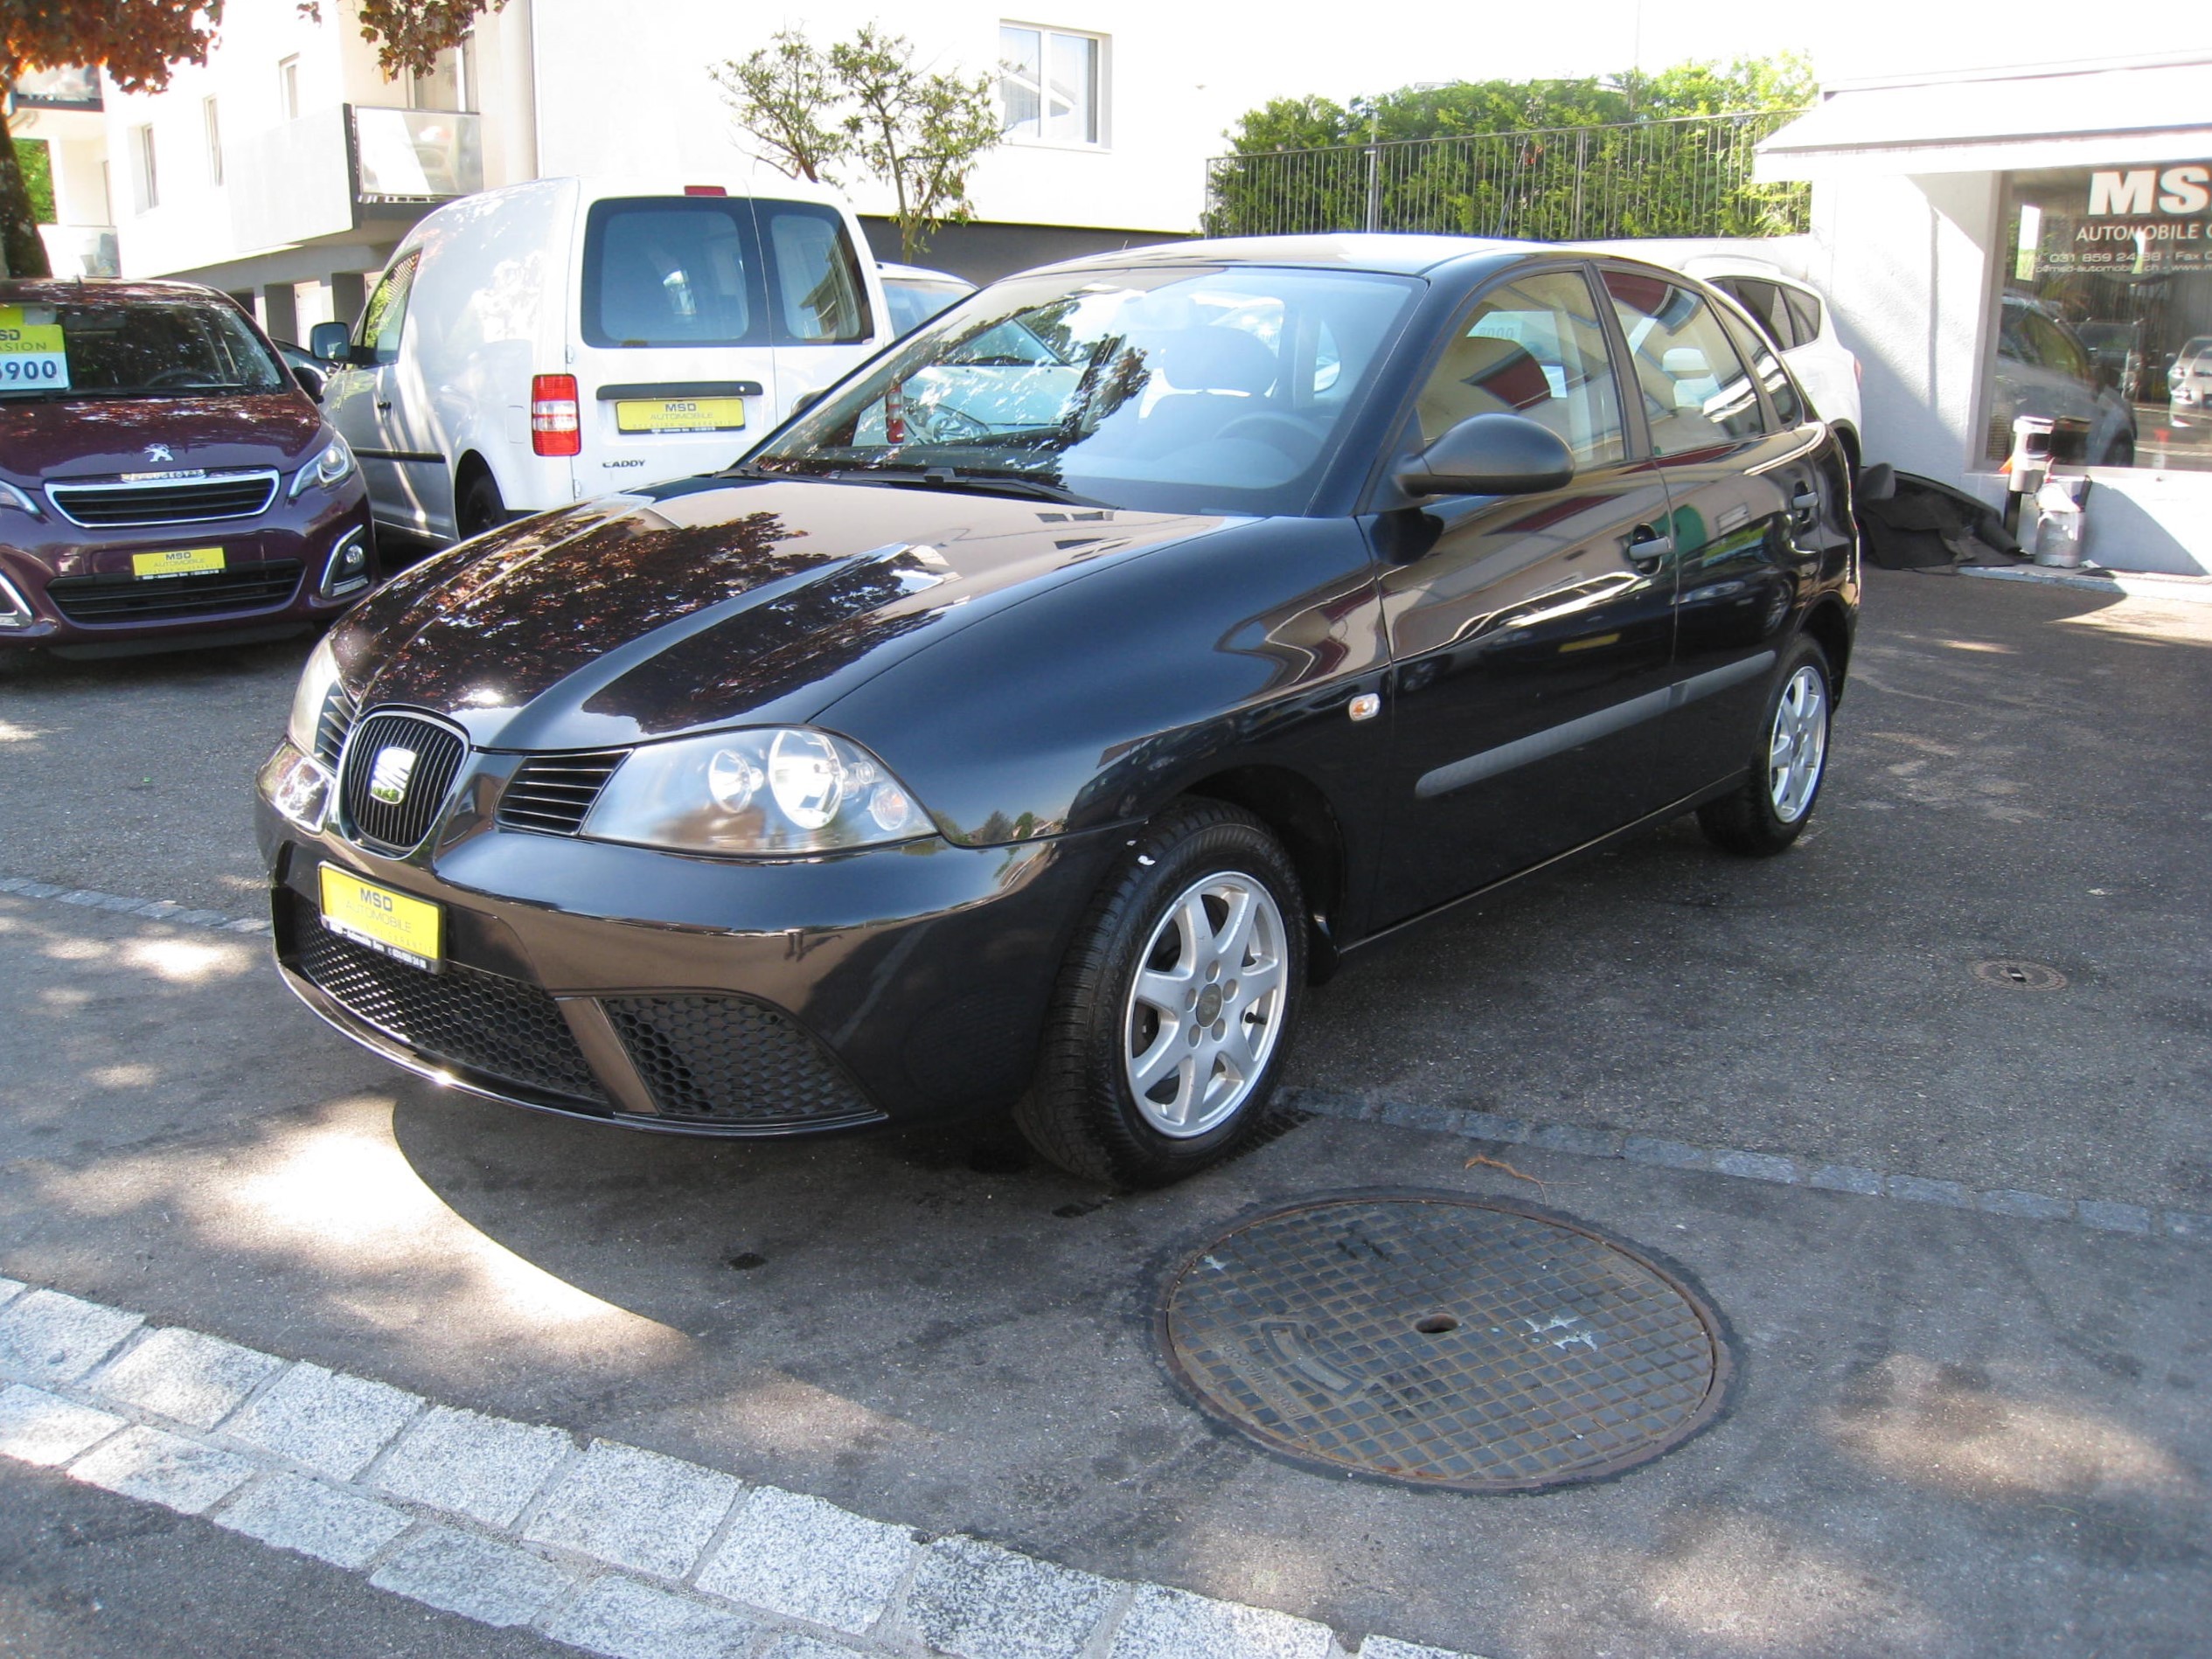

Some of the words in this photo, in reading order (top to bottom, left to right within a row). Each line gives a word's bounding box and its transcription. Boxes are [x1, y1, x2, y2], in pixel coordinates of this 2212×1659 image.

[2088, 165, 2212, 215] MS
[2076, 224, 2200, 241] AUTOMOBILE
[2049, 253, 2076, 263] 031
[2082, 253, 2112, 262] 859
[2175, 251, 2201, 260] Fax
[0, 329, 21, 341] SD
[0, 342, 47, 351] SION
[0, 360, 58, 380] 900
[664, 403, 697, 412] MSD
[650, 412, 713, 420] AUTOMOBILE
[602, 459, 645, 468] CADDY
[165, 552, 191, 560] MSD
[359, 887, 393, 912] MSD
[345, 899, 413, 934] AUTOMOBILE
